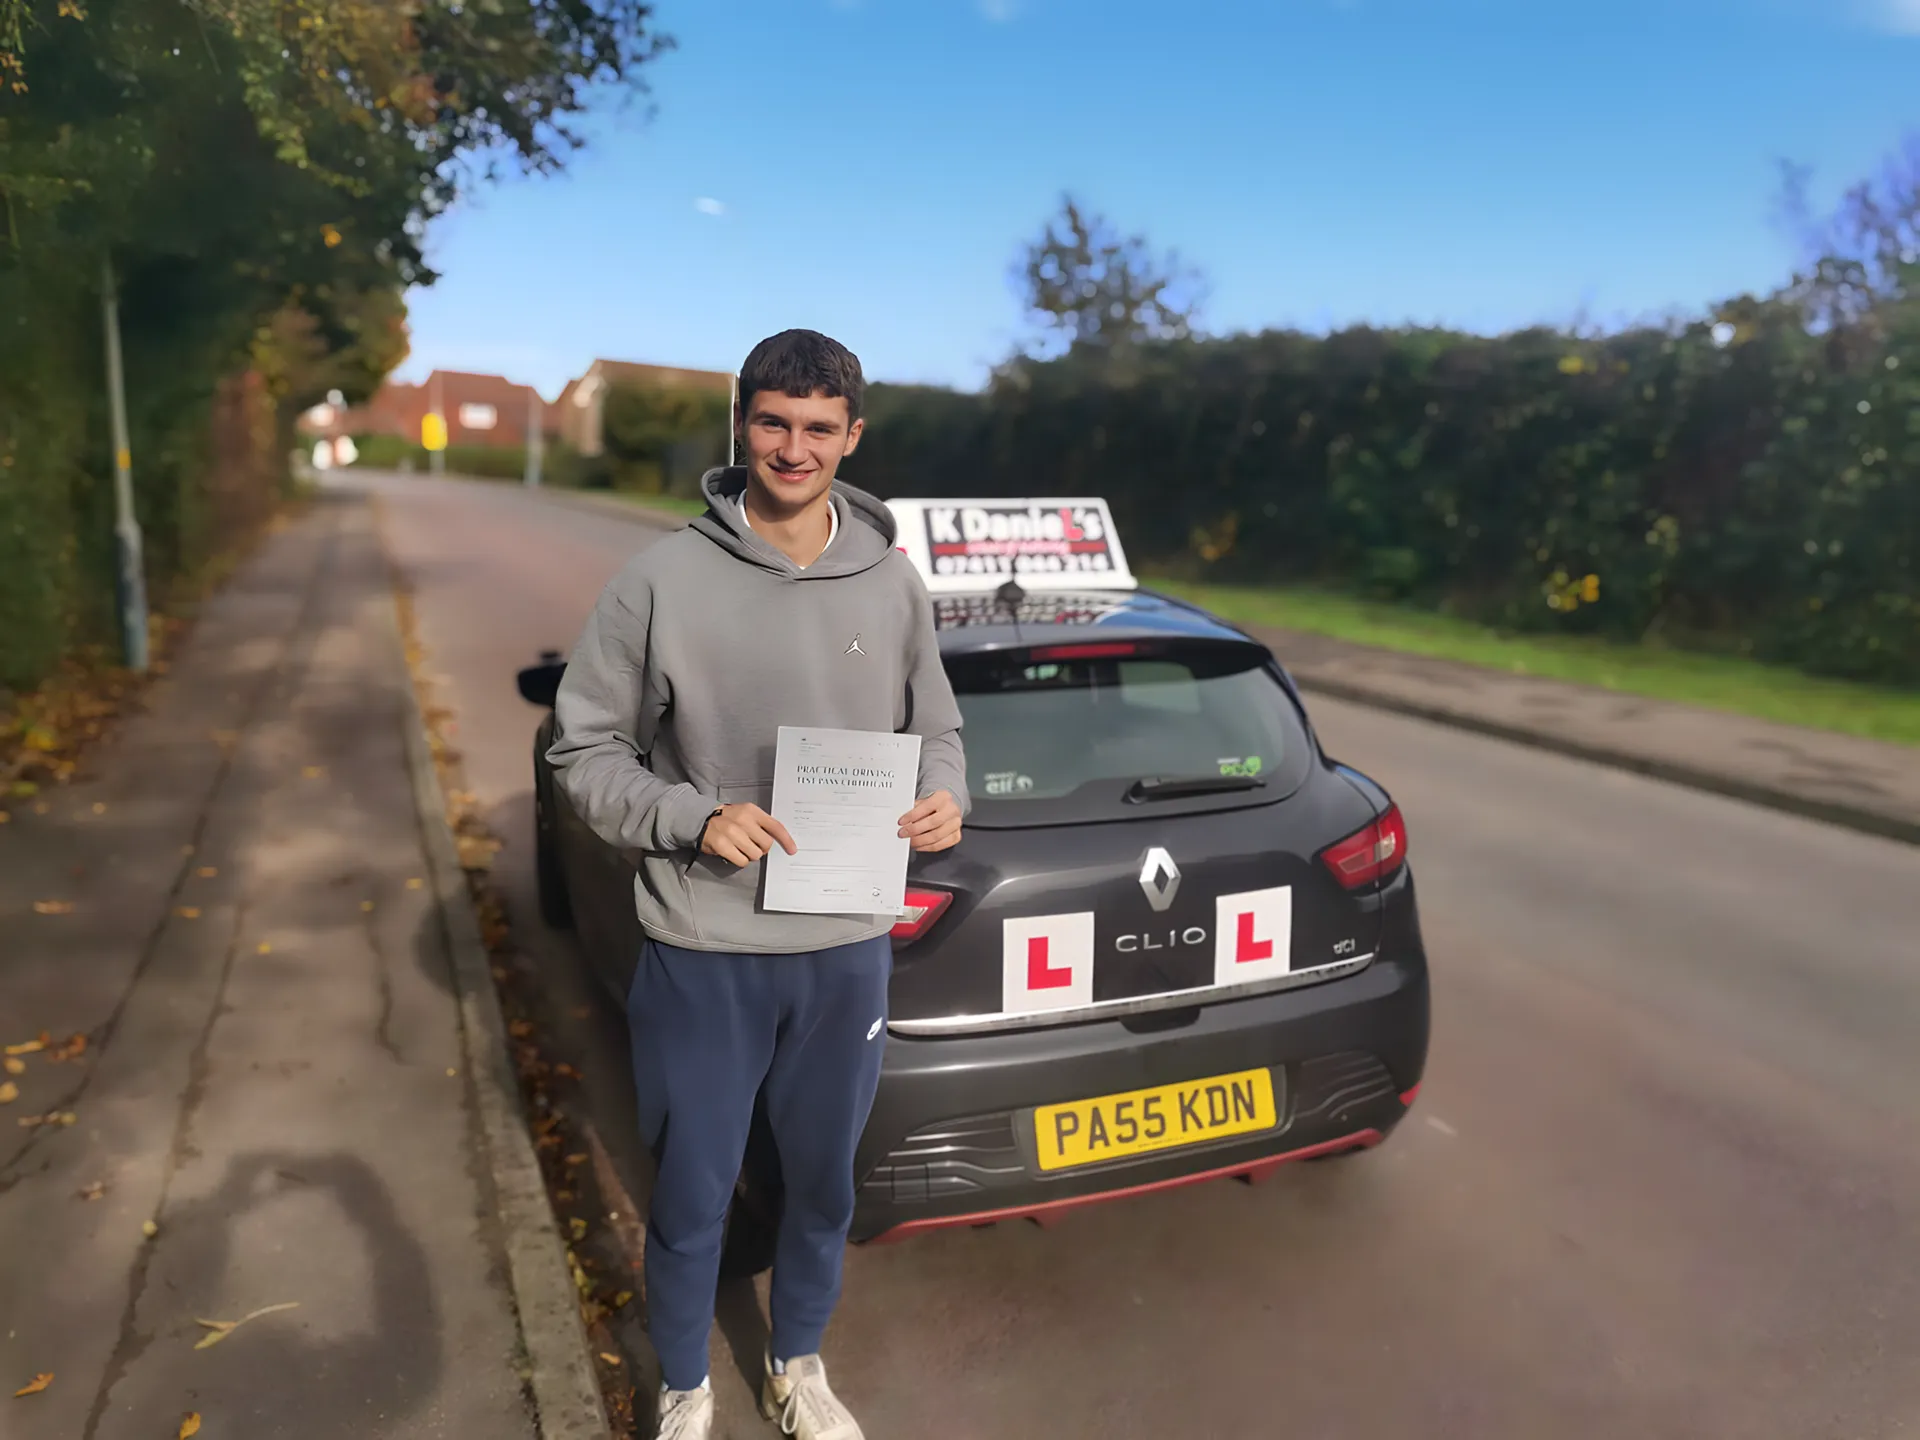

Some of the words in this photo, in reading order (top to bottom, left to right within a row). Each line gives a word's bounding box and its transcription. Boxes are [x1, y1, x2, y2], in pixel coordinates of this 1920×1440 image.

[930, 508, 962, 543] K
[797, 765, 848, 776] PRACTICAL
[852, 768, 895, 779] DRIVING
[841, 779, 893, 789] CERTIFICATE
[1114, 926, 1207, 953] CLIO
[1235, 911, 1273, 964] L
[1027, 936, 1073, 991] L
[1055, 1095, 1167, 1156] PA55
[1178, 1078, 1257, 1133] KDN
